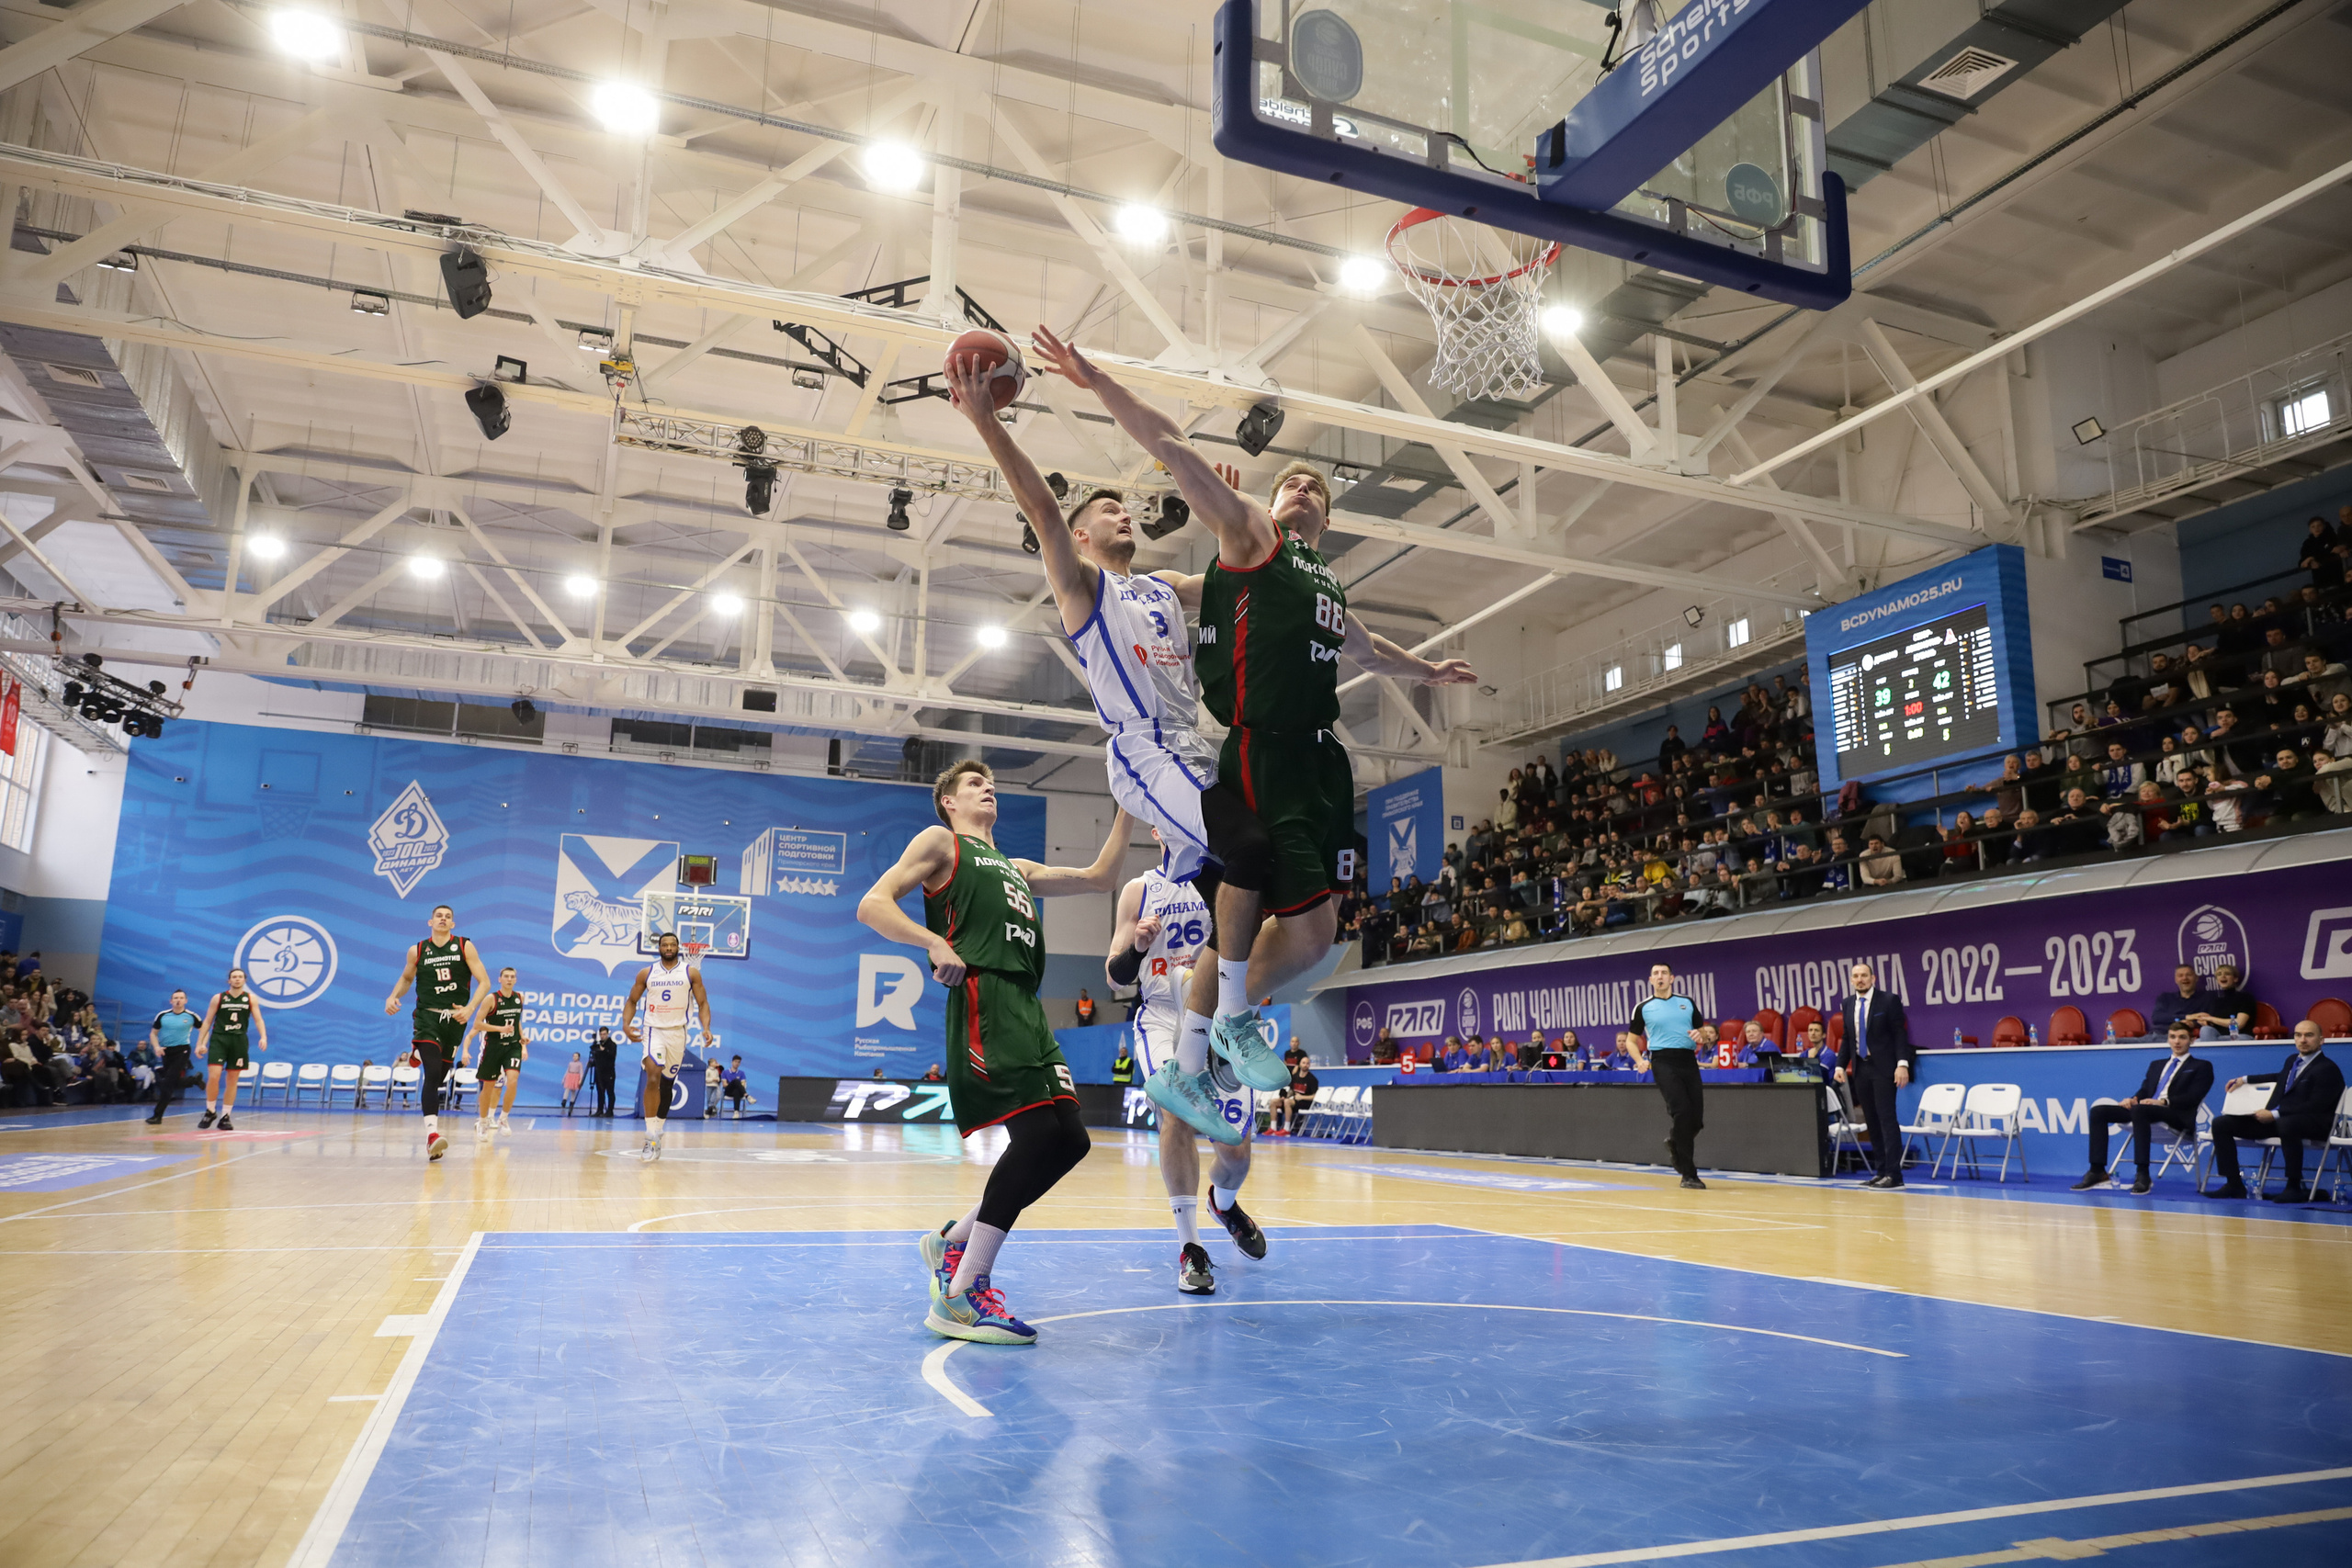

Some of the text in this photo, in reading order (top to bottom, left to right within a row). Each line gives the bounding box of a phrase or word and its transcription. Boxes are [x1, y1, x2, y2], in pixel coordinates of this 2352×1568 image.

[1840, 577, 1963, 632] BCDYNAMO25.RU
[1315, 592, 1347, 638] 88
[1149, 611, 1169, 638] 3
[1932, 671, 1951, 690] 42
[1874, 687, 1892, 707] 39
[779, 834, 808, 842] ЦЕНТР
[778, 842, 836, 852] СПОРТИВНОЙ
[778, 850, 834, 860] ПОДГОТОВКИ
[379, 856, 437, 870] ДИНАМО
[1002, 881, 1035, 920] 55
[678, 905, 714, 917] PARI
[1166, 919, 1204, 950] 26
[2198, 942, 2227, 953] PARI
[435, 967, 452, 982] 18
[517, 991, 555, 1007] РИ
[662, 989, 672, 1001] 6
[230, 1012, 238, 1021] 4
[1389, 1003, 1442, 1032] PARI
[1493, 991, 1527, 1032] PARI
[1356, 1017, 1374, 1030] РФБ
[510, 1057, 520, 1067] 17
[1719, 1043, 1731, 1066] 5
[236, 1058, 243, 1067] 4
[670, 1064, 680, 1074] 6
[1402, 1055, 1414, 1073] 5
